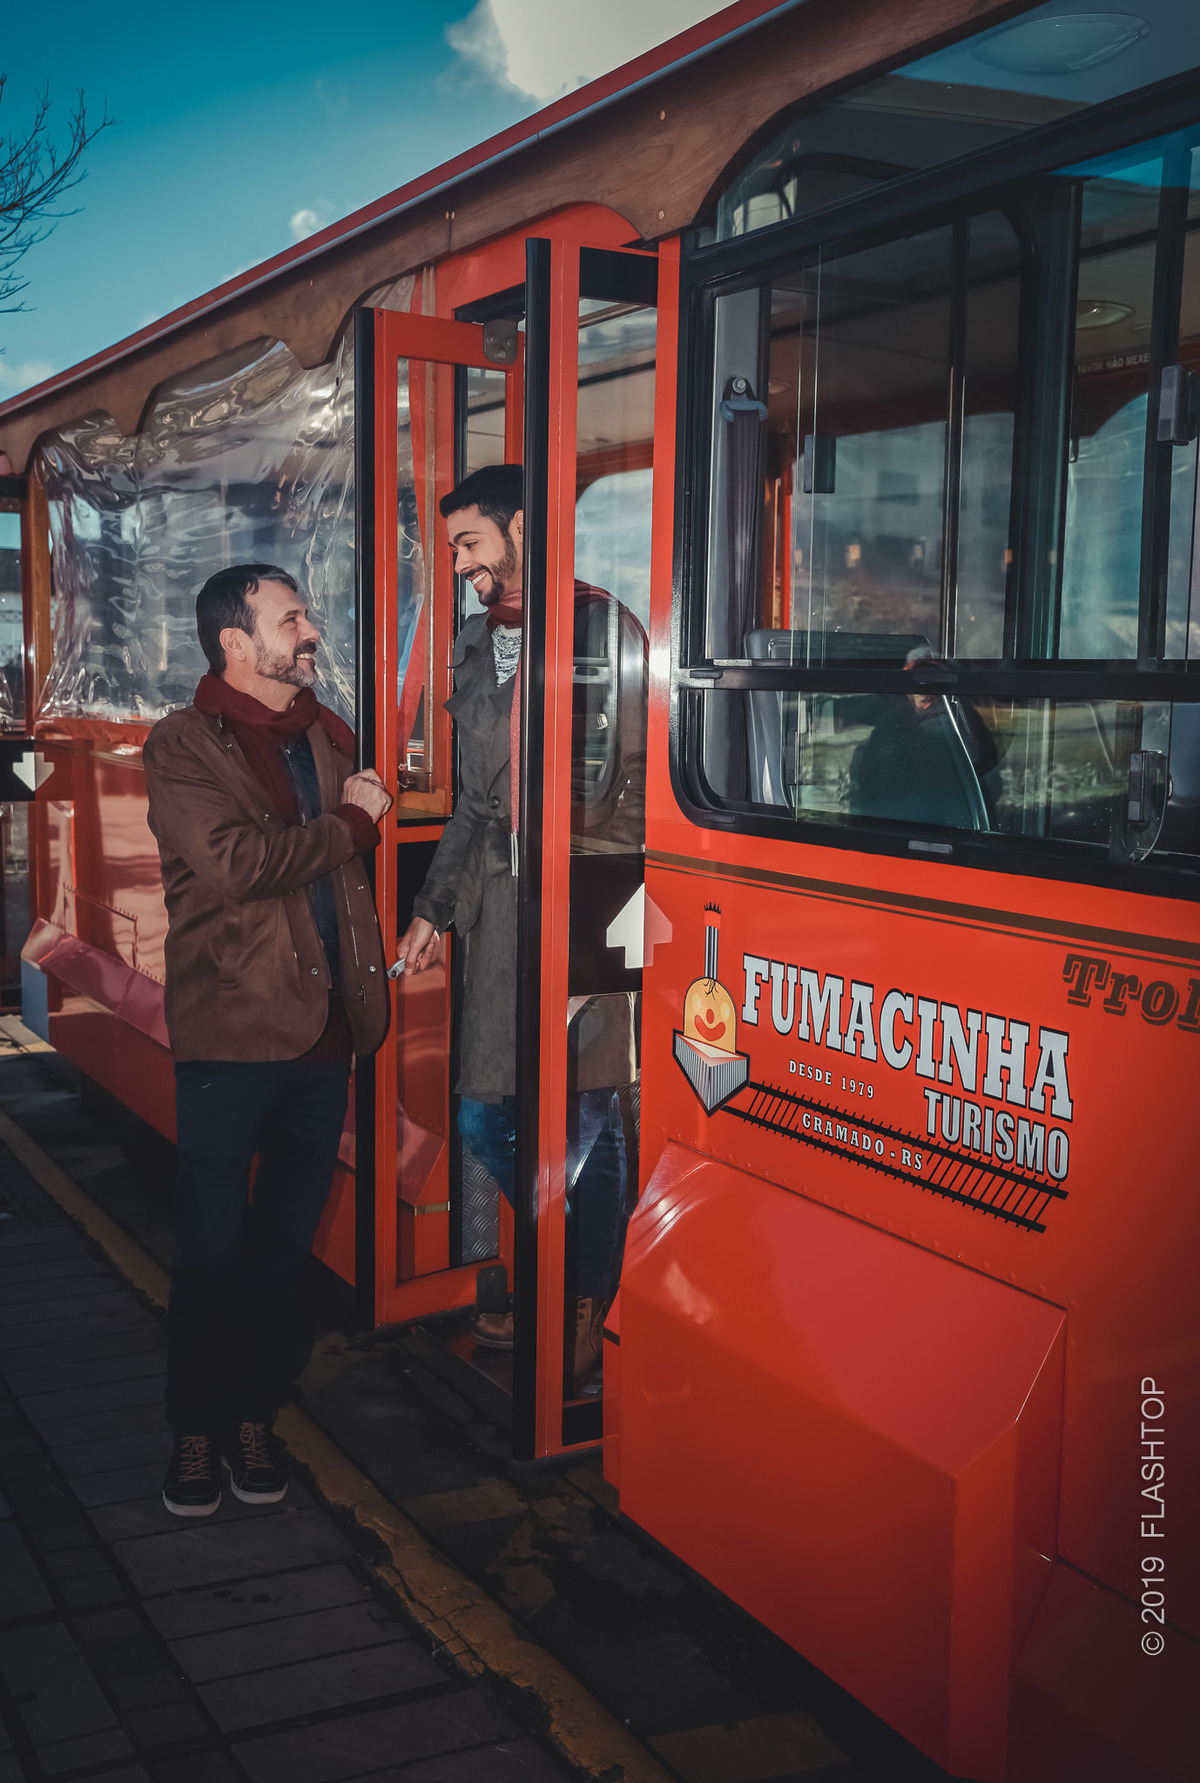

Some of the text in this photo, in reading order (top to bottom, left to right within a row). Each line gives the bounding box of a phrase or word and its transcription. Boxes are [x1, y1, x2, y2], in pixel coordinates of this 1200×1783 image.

[742, 952, 1073, 1121] FUMACINHA
[789, 1059, 874, 1099] DESDE 1979
[802, 1112, 885, 1156] GRAMADO
[901, 1147, 922, 1170] RS
[924, 1086, 1070, 1182] TURISMO
